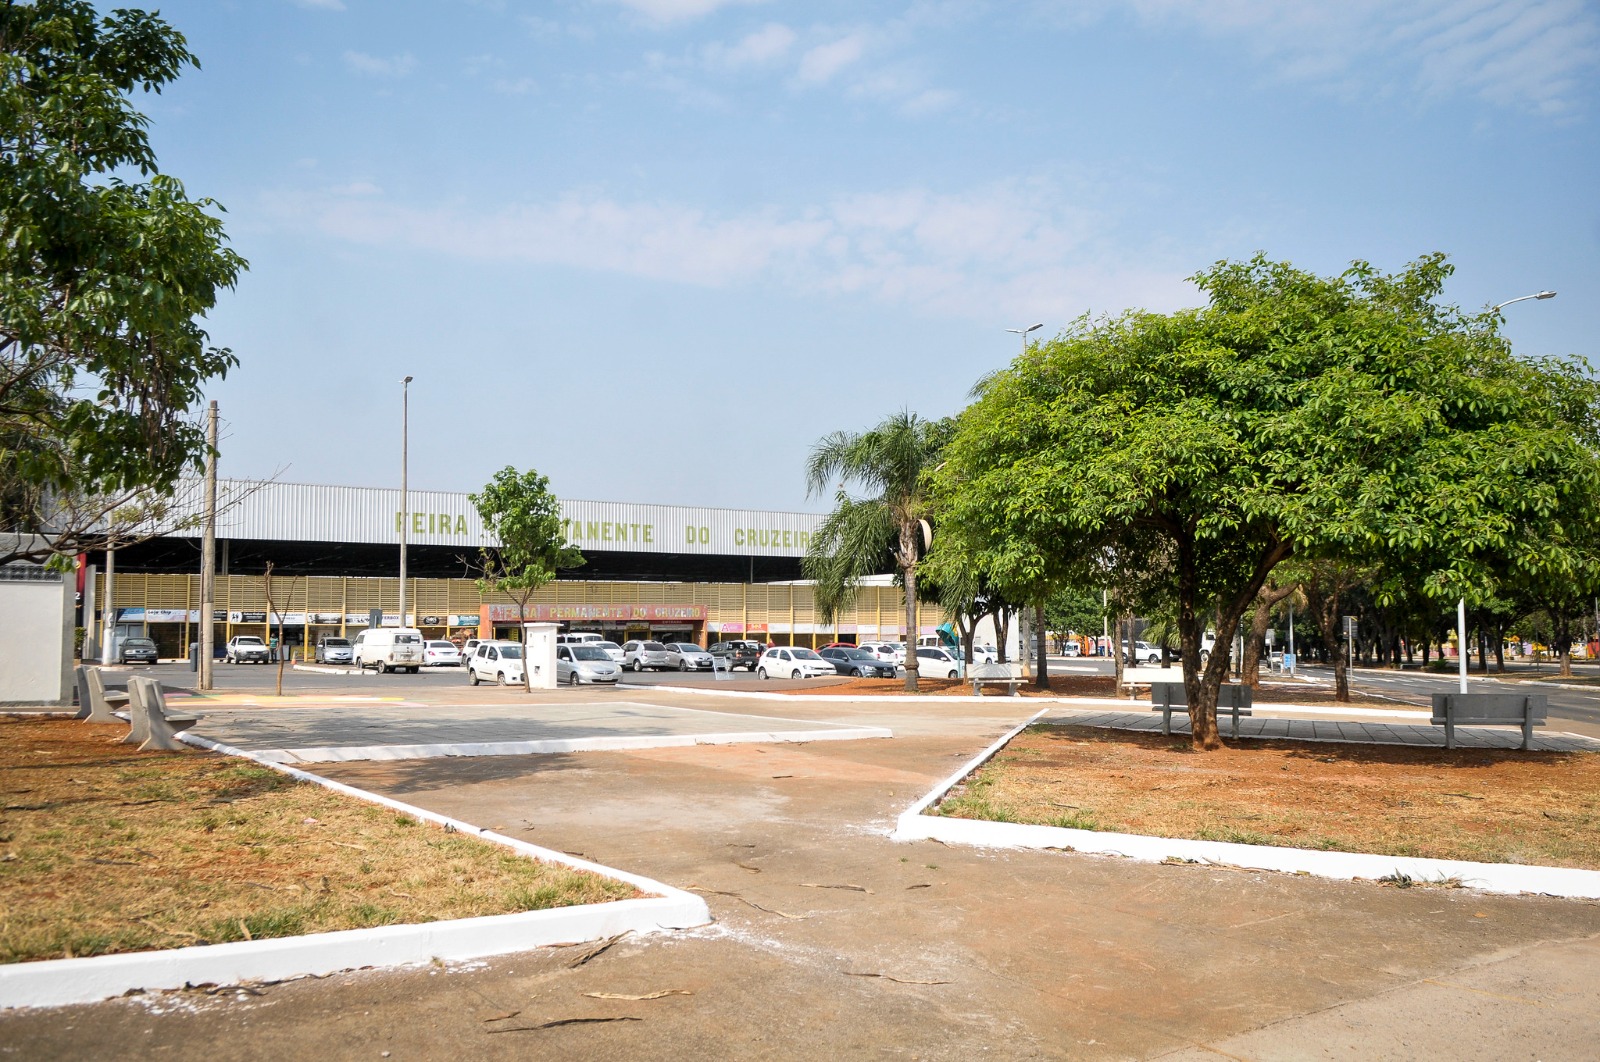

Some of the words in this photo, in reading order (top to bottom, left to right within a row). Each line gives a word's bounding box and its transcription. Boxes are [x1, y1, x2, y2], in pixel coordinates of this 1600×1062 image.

[396, 512, 468, 535] FEIRA
[686, 526, 710, 544] DO
[505, 607, 537, 618] FERA
[633, 607, 647, 617] DO
[655, 607, 700, 617] CRUZEIRO
